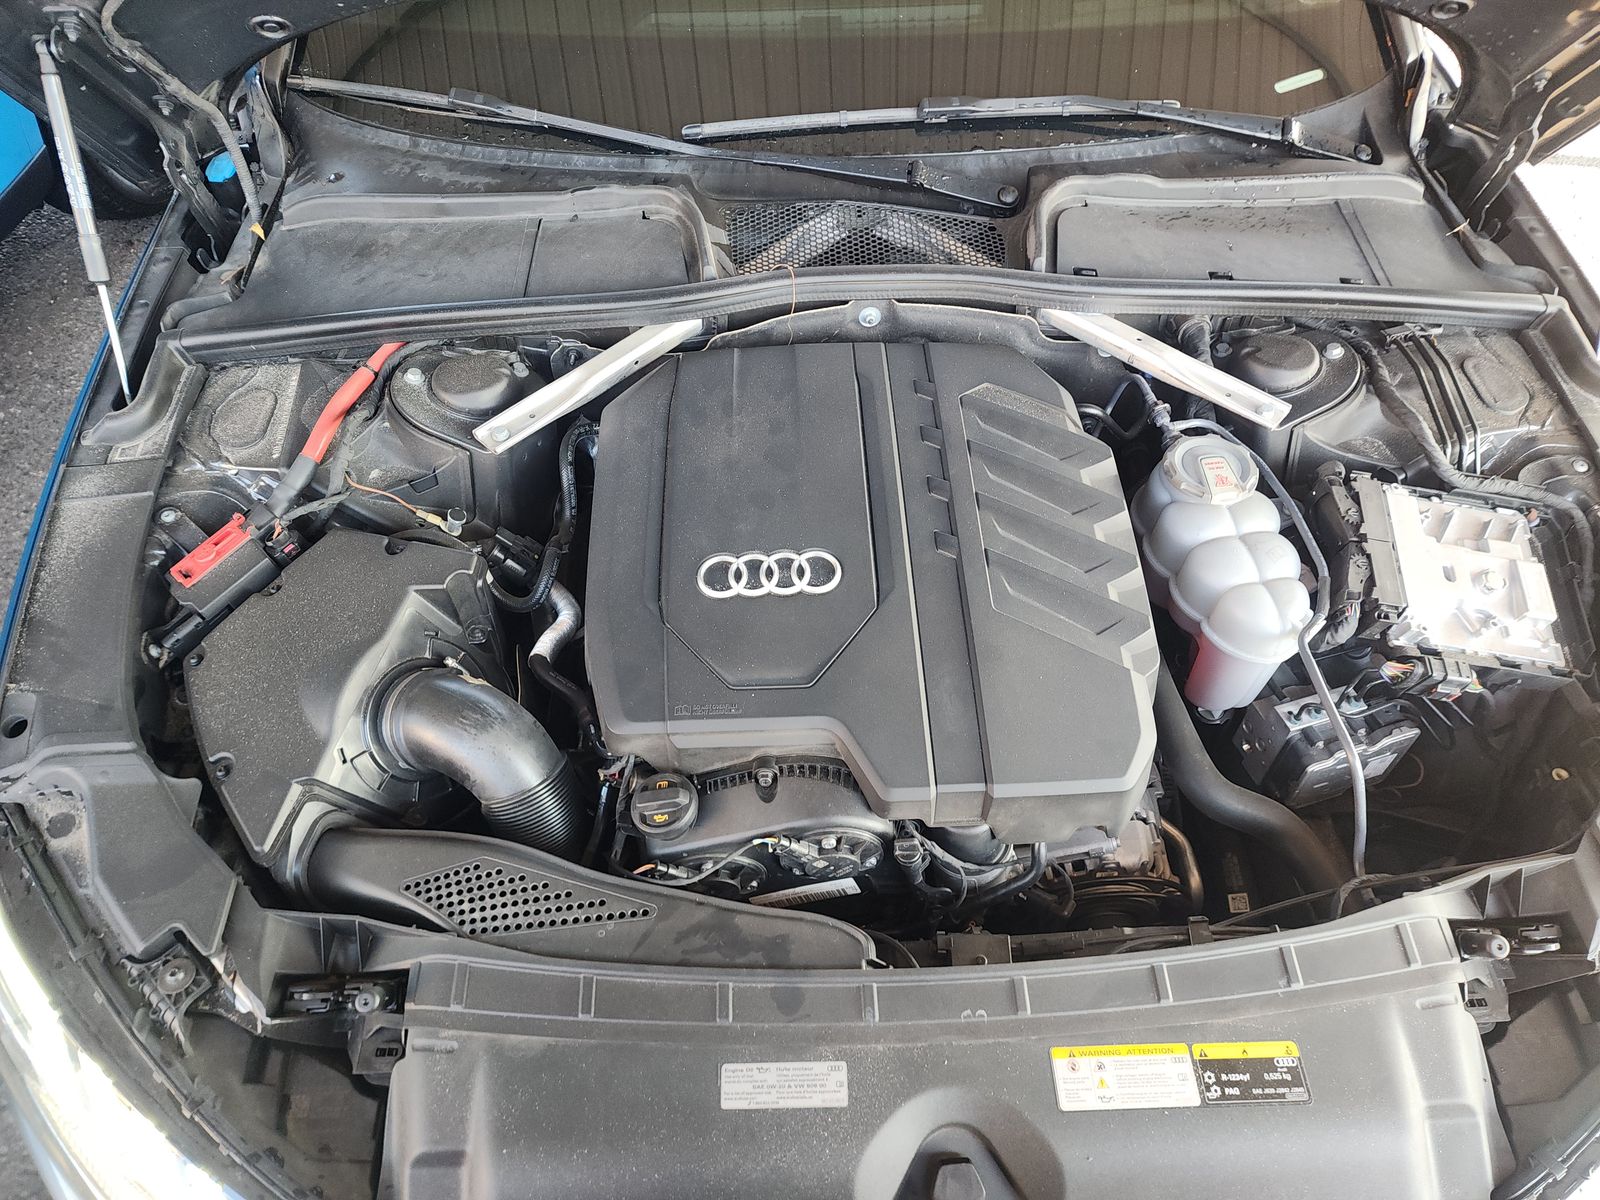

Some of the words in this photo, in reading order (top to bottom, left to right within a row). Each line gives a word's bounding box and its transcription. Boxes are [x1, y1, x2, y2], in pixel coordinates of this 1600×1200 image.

[1078, 1049, 1121, 1057] WARNING
[1126, 1047, 1174, 1055] ATTENTION
[1282, 1072, 1292, 1081] kg
